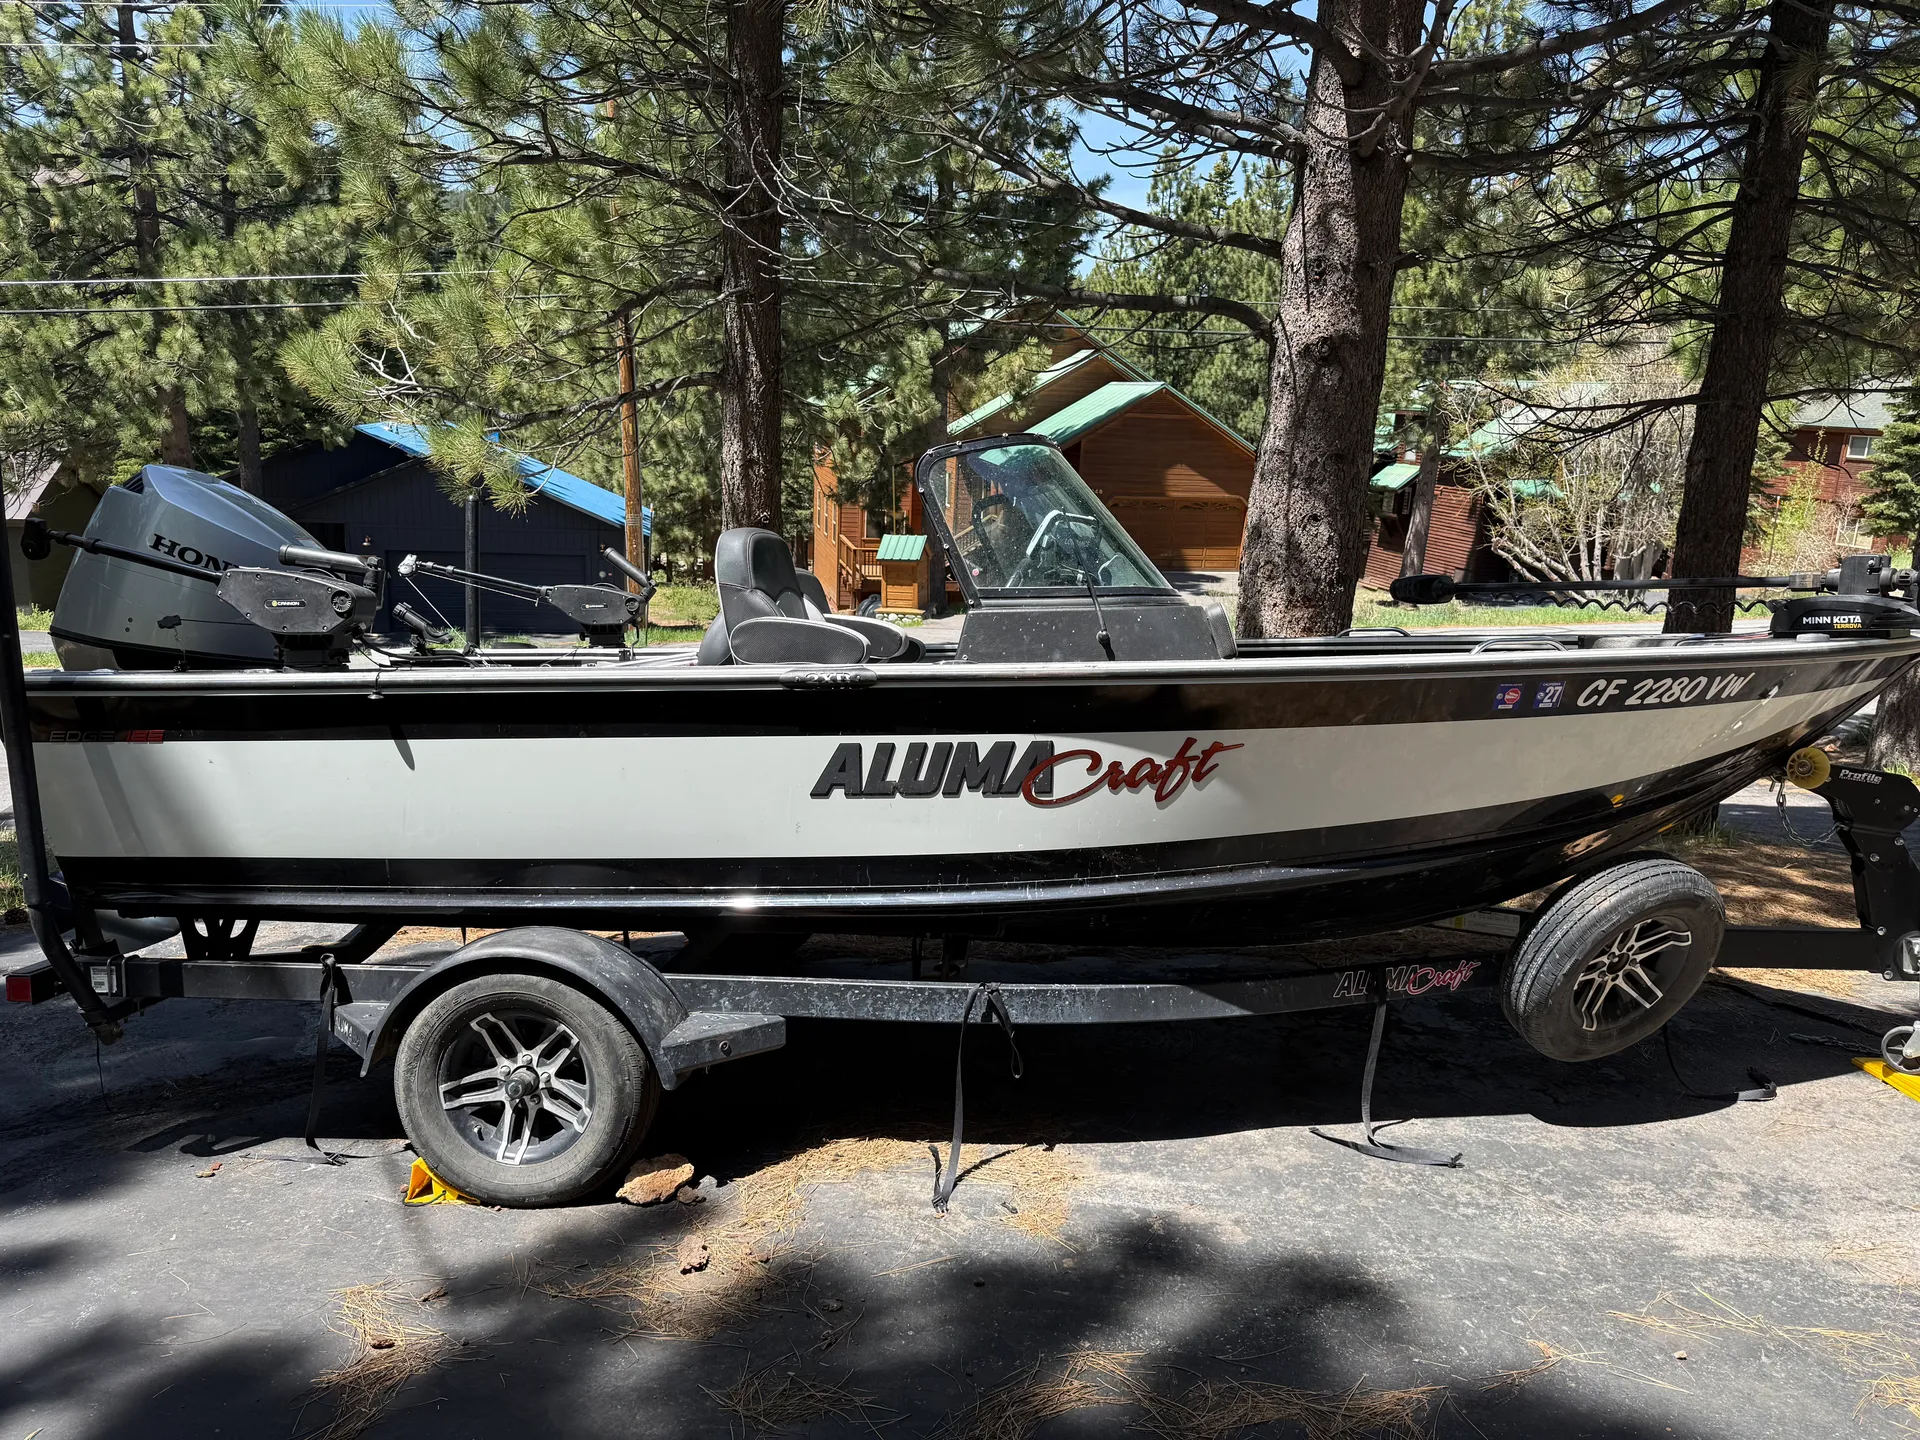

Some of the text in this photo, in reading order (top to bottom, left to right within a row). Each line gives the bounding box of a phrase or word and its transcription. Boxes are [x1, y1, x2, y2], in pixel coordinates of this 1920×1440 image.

[149, 533, 239, 571] HON
[1802, 615, 1862, 625] MINN KOTA
[1543, 686, 1563, 703] 27
[1576, 672, 1756, 707] CF 2280 VW
[49, 730, 115, 742] EDGE
[1840, 768, 1882, 783] Profile
